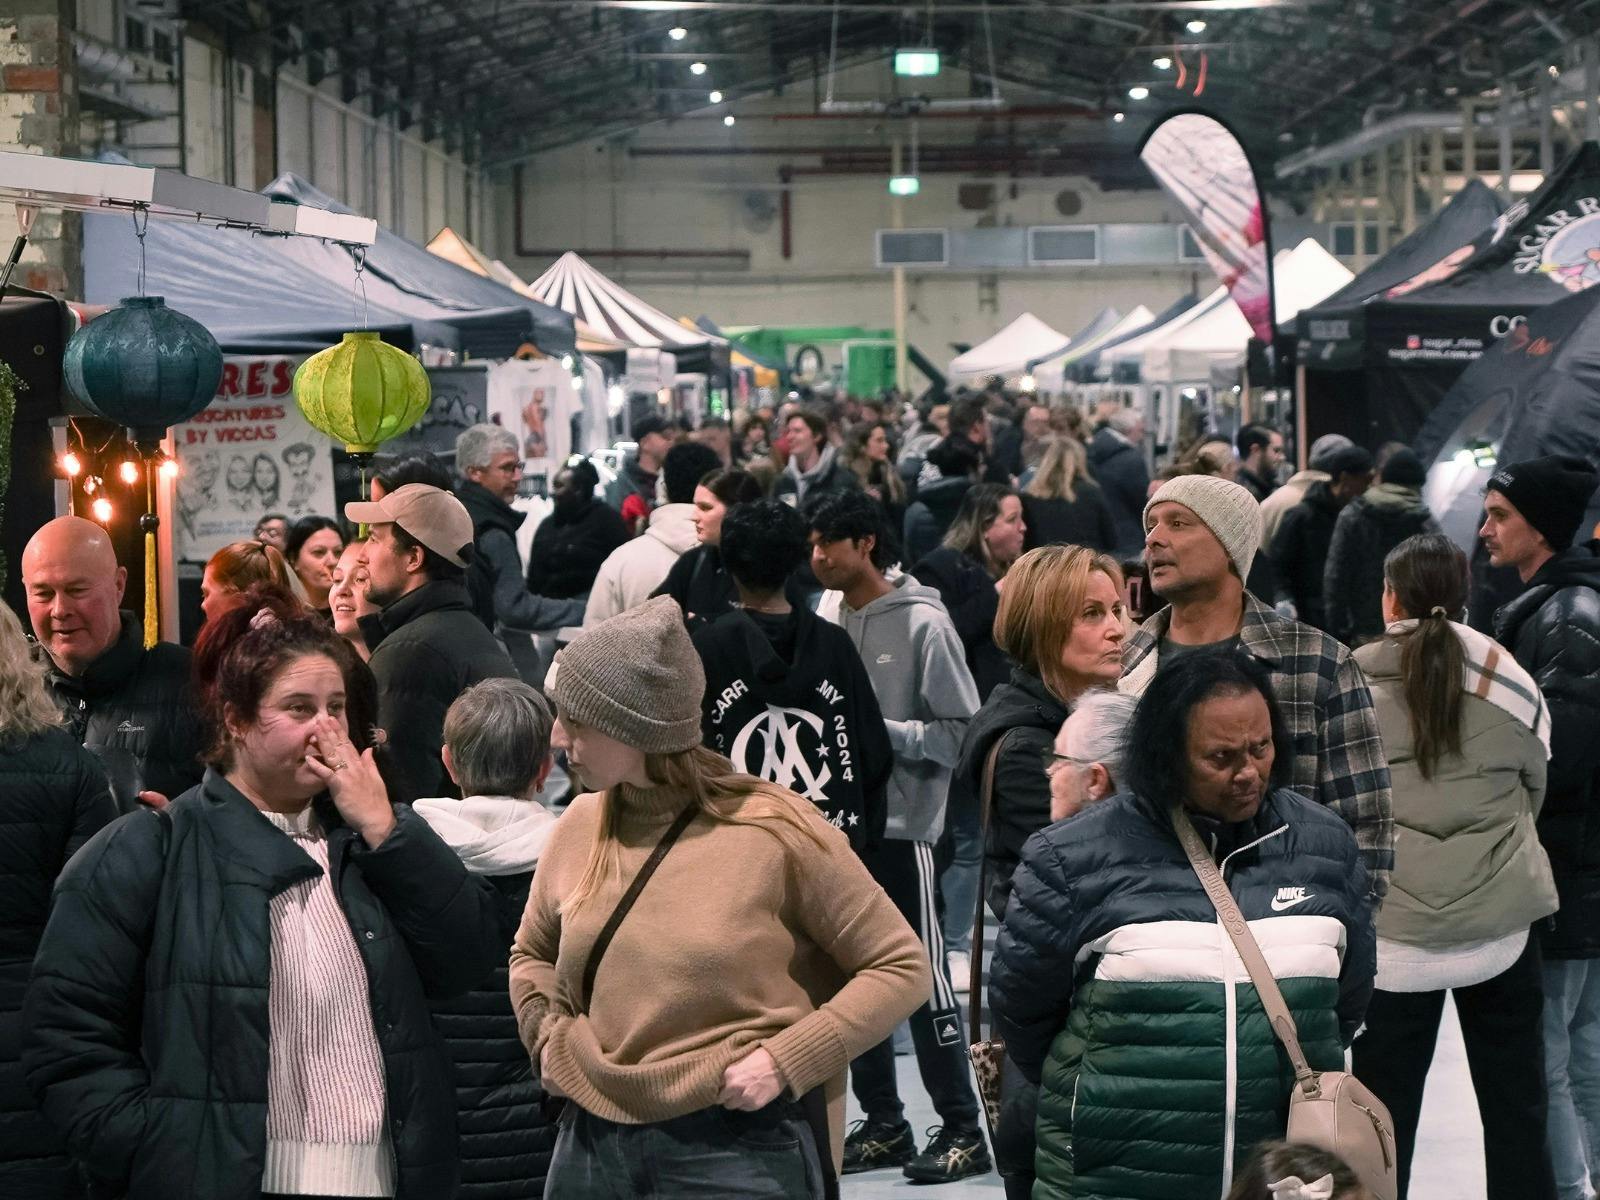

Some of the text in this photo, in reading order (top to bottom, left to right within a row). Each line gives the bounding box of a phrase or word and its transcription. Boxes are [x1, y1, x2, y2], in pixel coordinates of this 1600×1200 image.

[1512, 209, 1578, 274] SUGAR
[186, 429, 208, 444] BY
[815, 679, 845, 705] MY
[833, 714, 854, 782] 2024
[1276, 886, 1306, 900] NIKE
